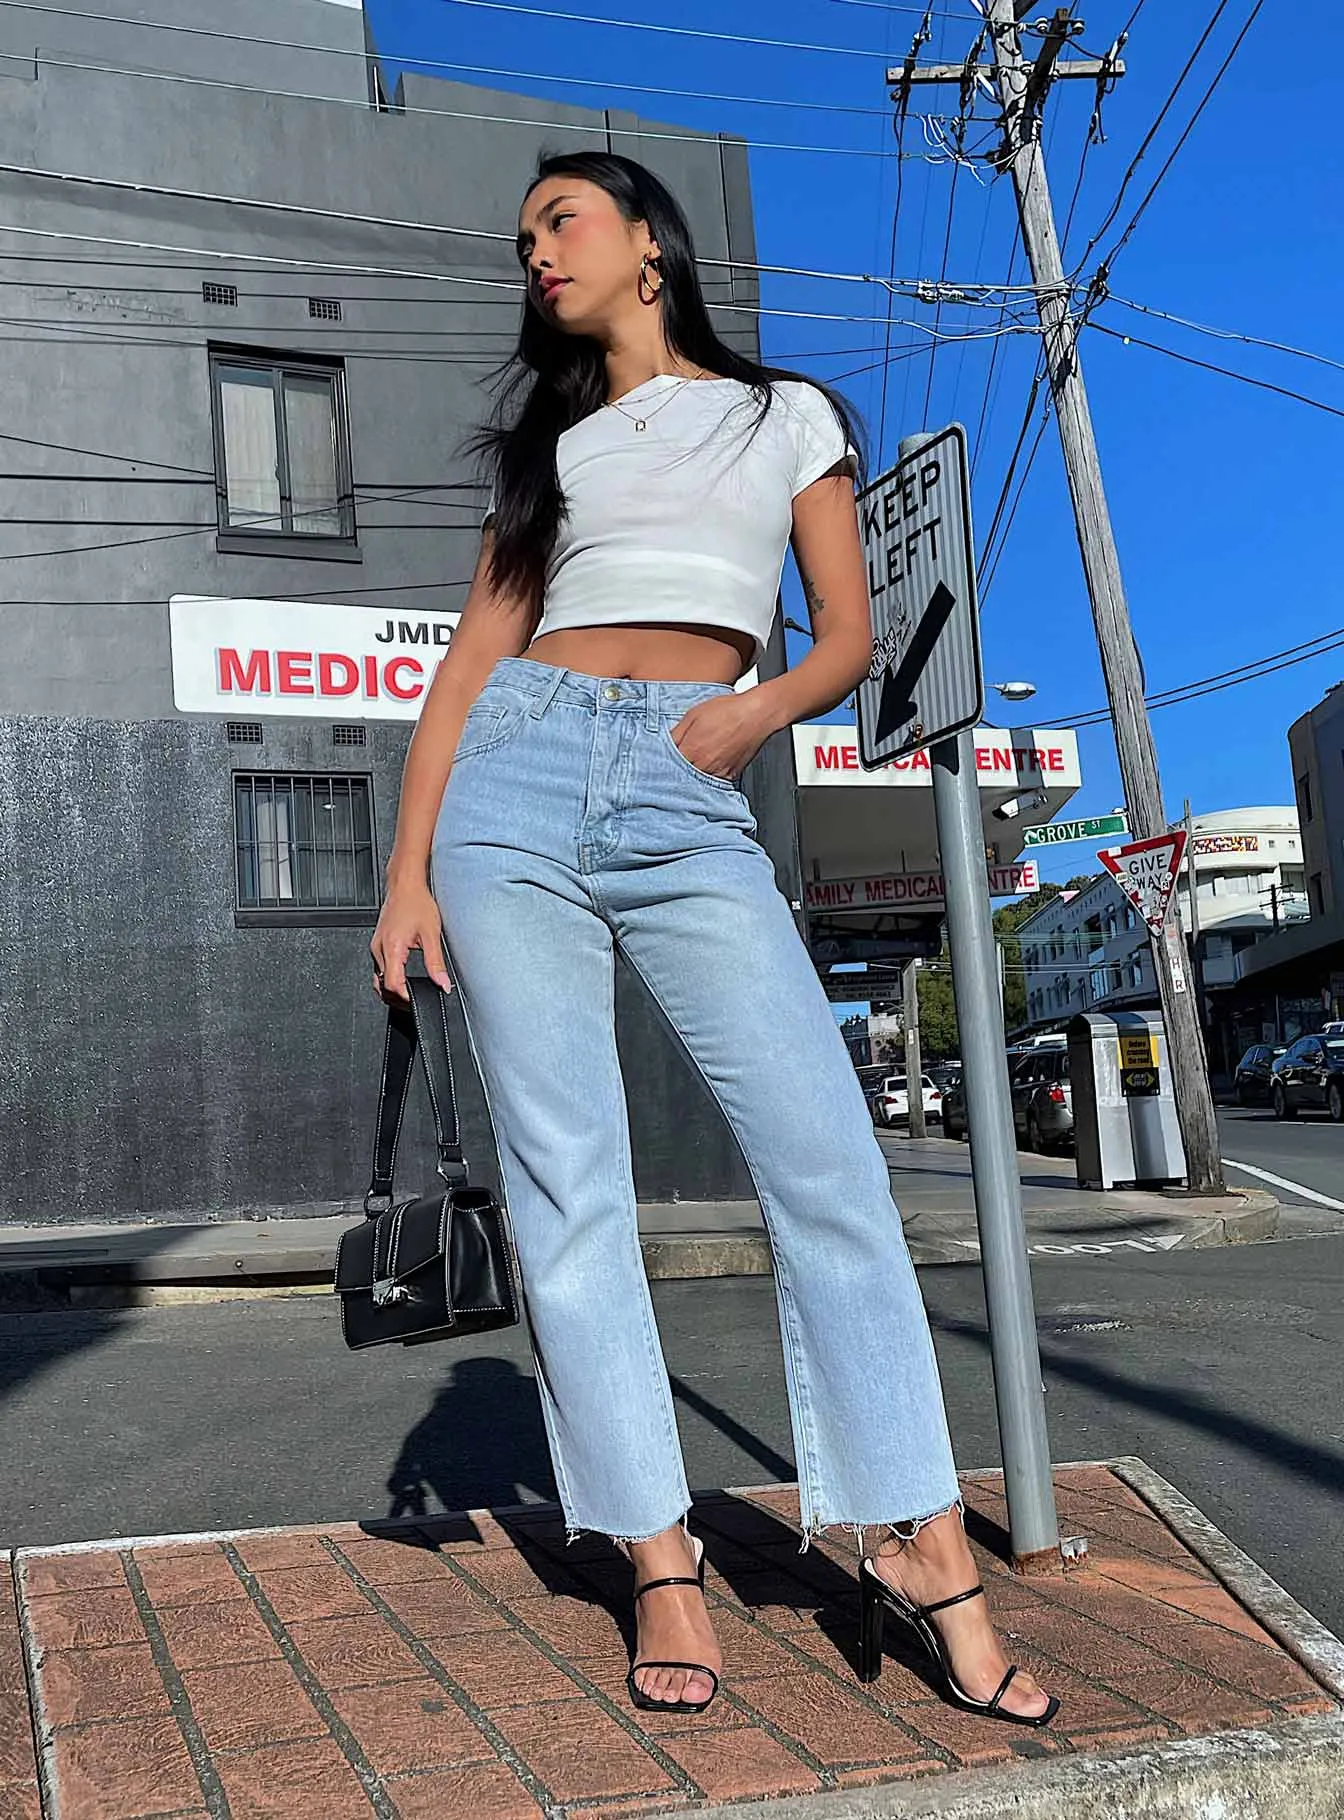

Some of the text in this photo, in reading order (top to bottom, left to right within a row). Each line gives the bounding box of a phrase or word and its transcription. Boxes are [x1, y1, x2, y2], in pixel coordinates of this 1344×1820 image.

[864, 460, 940, 546] KEEP
[869, 517, 941, 599] LEFT
[375, 620, 456, 646] JMD
[217, 648, 425, 700] MEDIC
[975, 748, 1065, 771] ENTRE
[1036, 820, 1100, 843] GROVE ST
[1129, 853, 1167, 875] GIVE
[805, 882, 855, 906] AMILY
[989, 866, 1035, 890] NTRE
[1136, 873, 1162, 889] WAY
[1027, 1239, 1157, 1254] LOO
